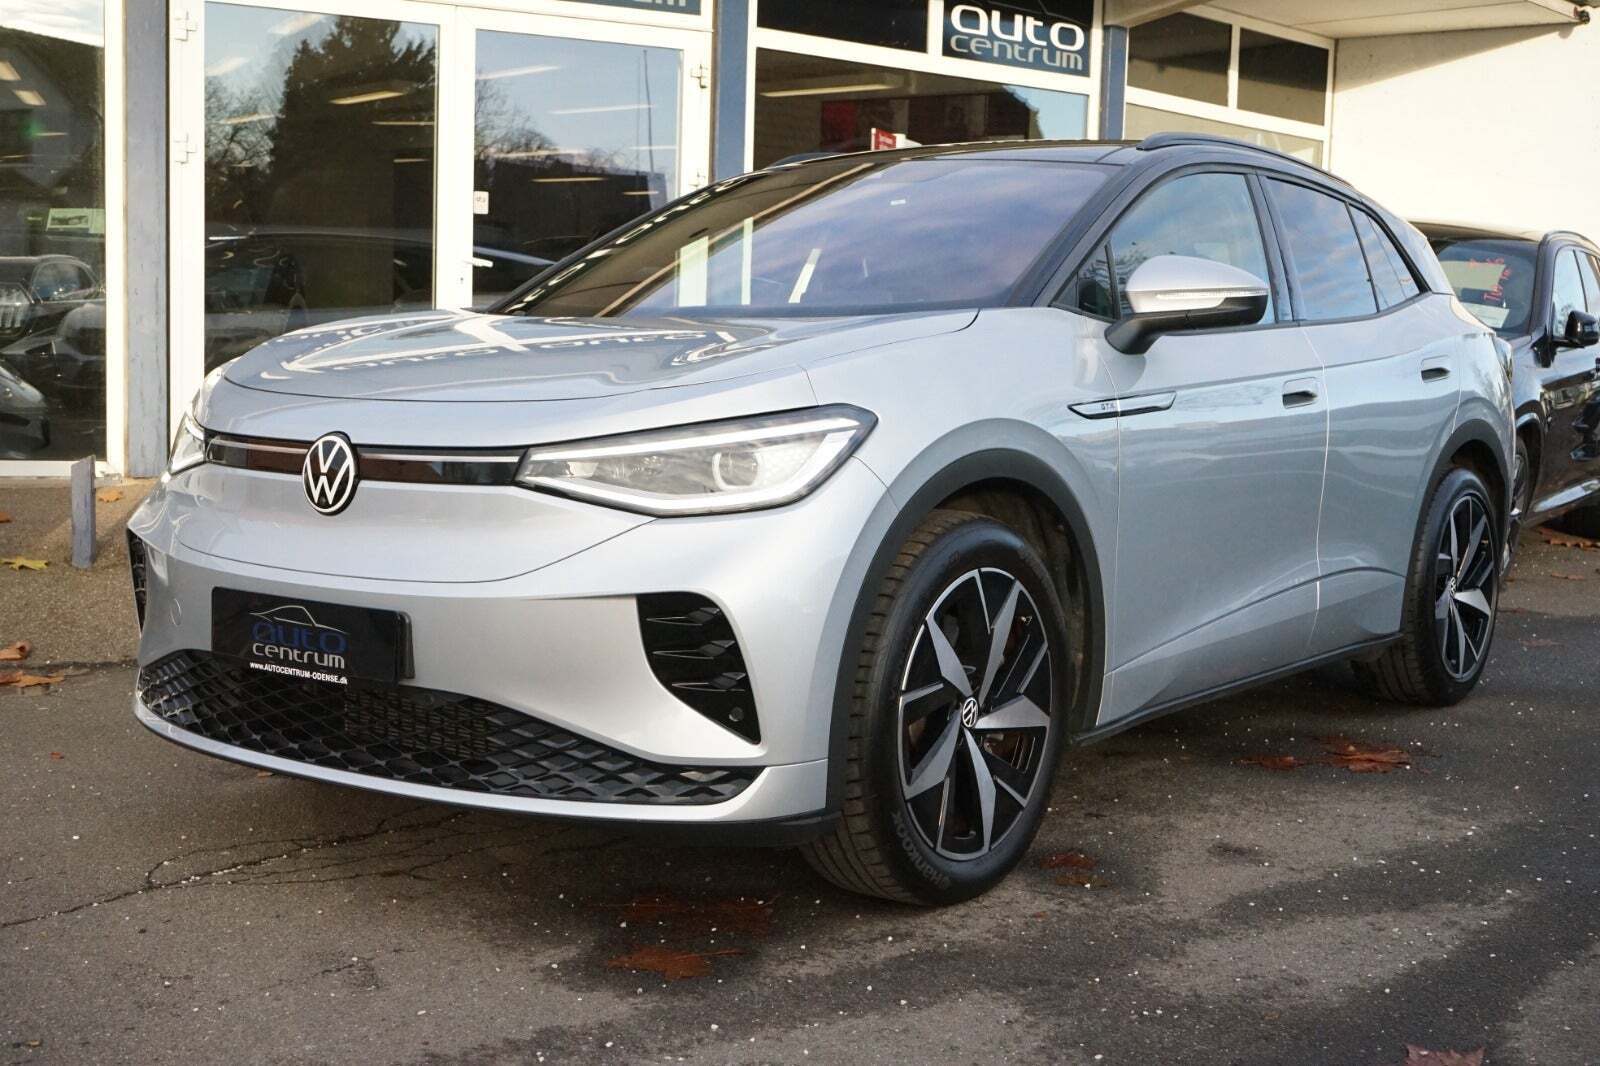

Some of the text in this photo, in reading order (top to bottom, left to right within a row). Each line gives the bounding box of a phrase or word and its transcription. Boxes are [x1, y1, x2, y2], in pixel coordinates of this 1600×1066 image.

[950, 4, 1085, 51] auto
[950, 35, 1083, 71] centrum
[252, 621, 347, 653] auto
[252, 642, 345, 669] centrum
[250, 662, 348, 684] www.AUTOCENTRUM-ODENSE.dk
